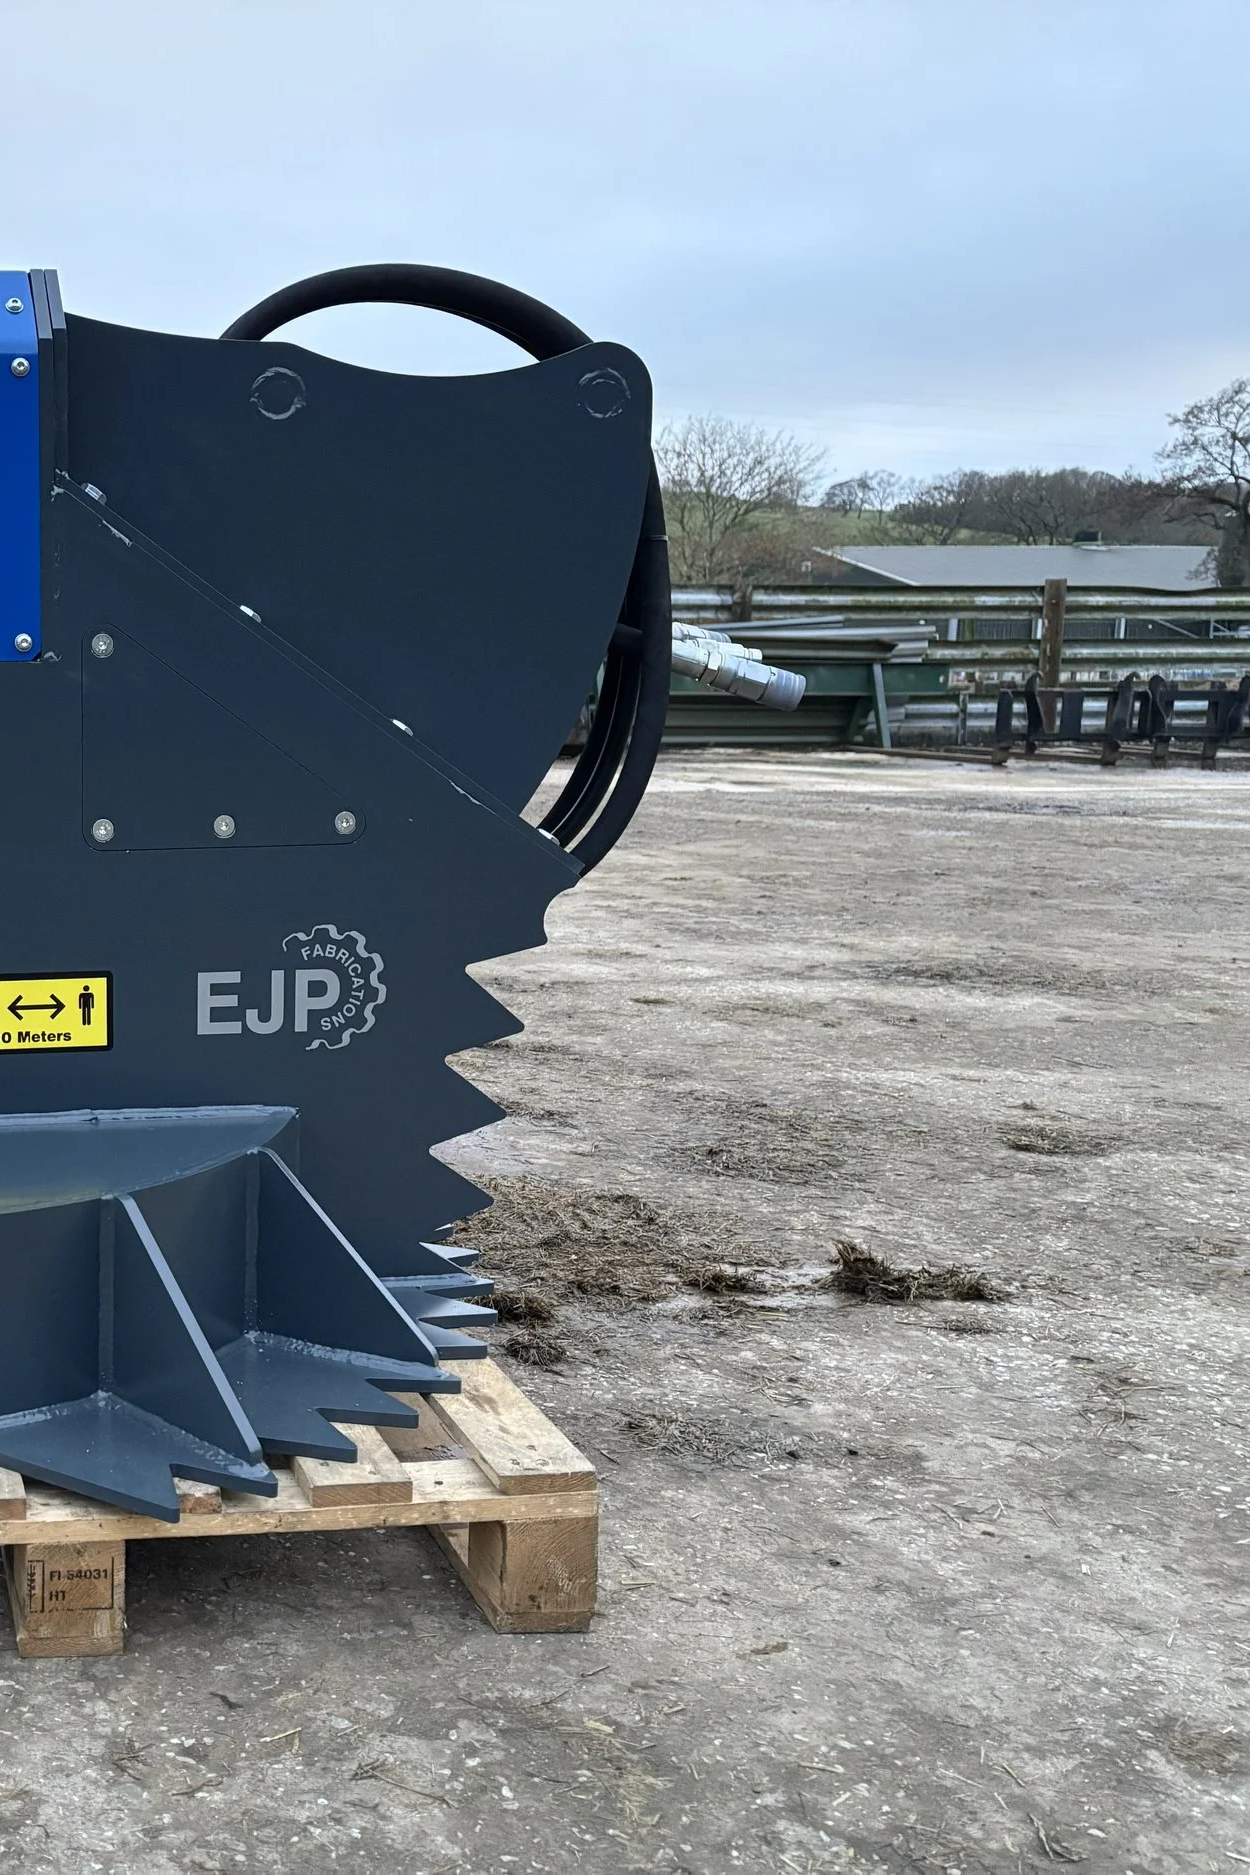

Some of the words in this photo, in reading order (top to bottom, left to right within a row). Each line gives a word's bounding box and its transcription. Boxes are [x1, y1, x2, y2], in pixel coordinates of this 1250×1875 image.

[197, 968, 341, 1035] EJP
[300, 943, 365, 1031] FABRICATIONS
[17, 1030, 72, 1044] Meters
